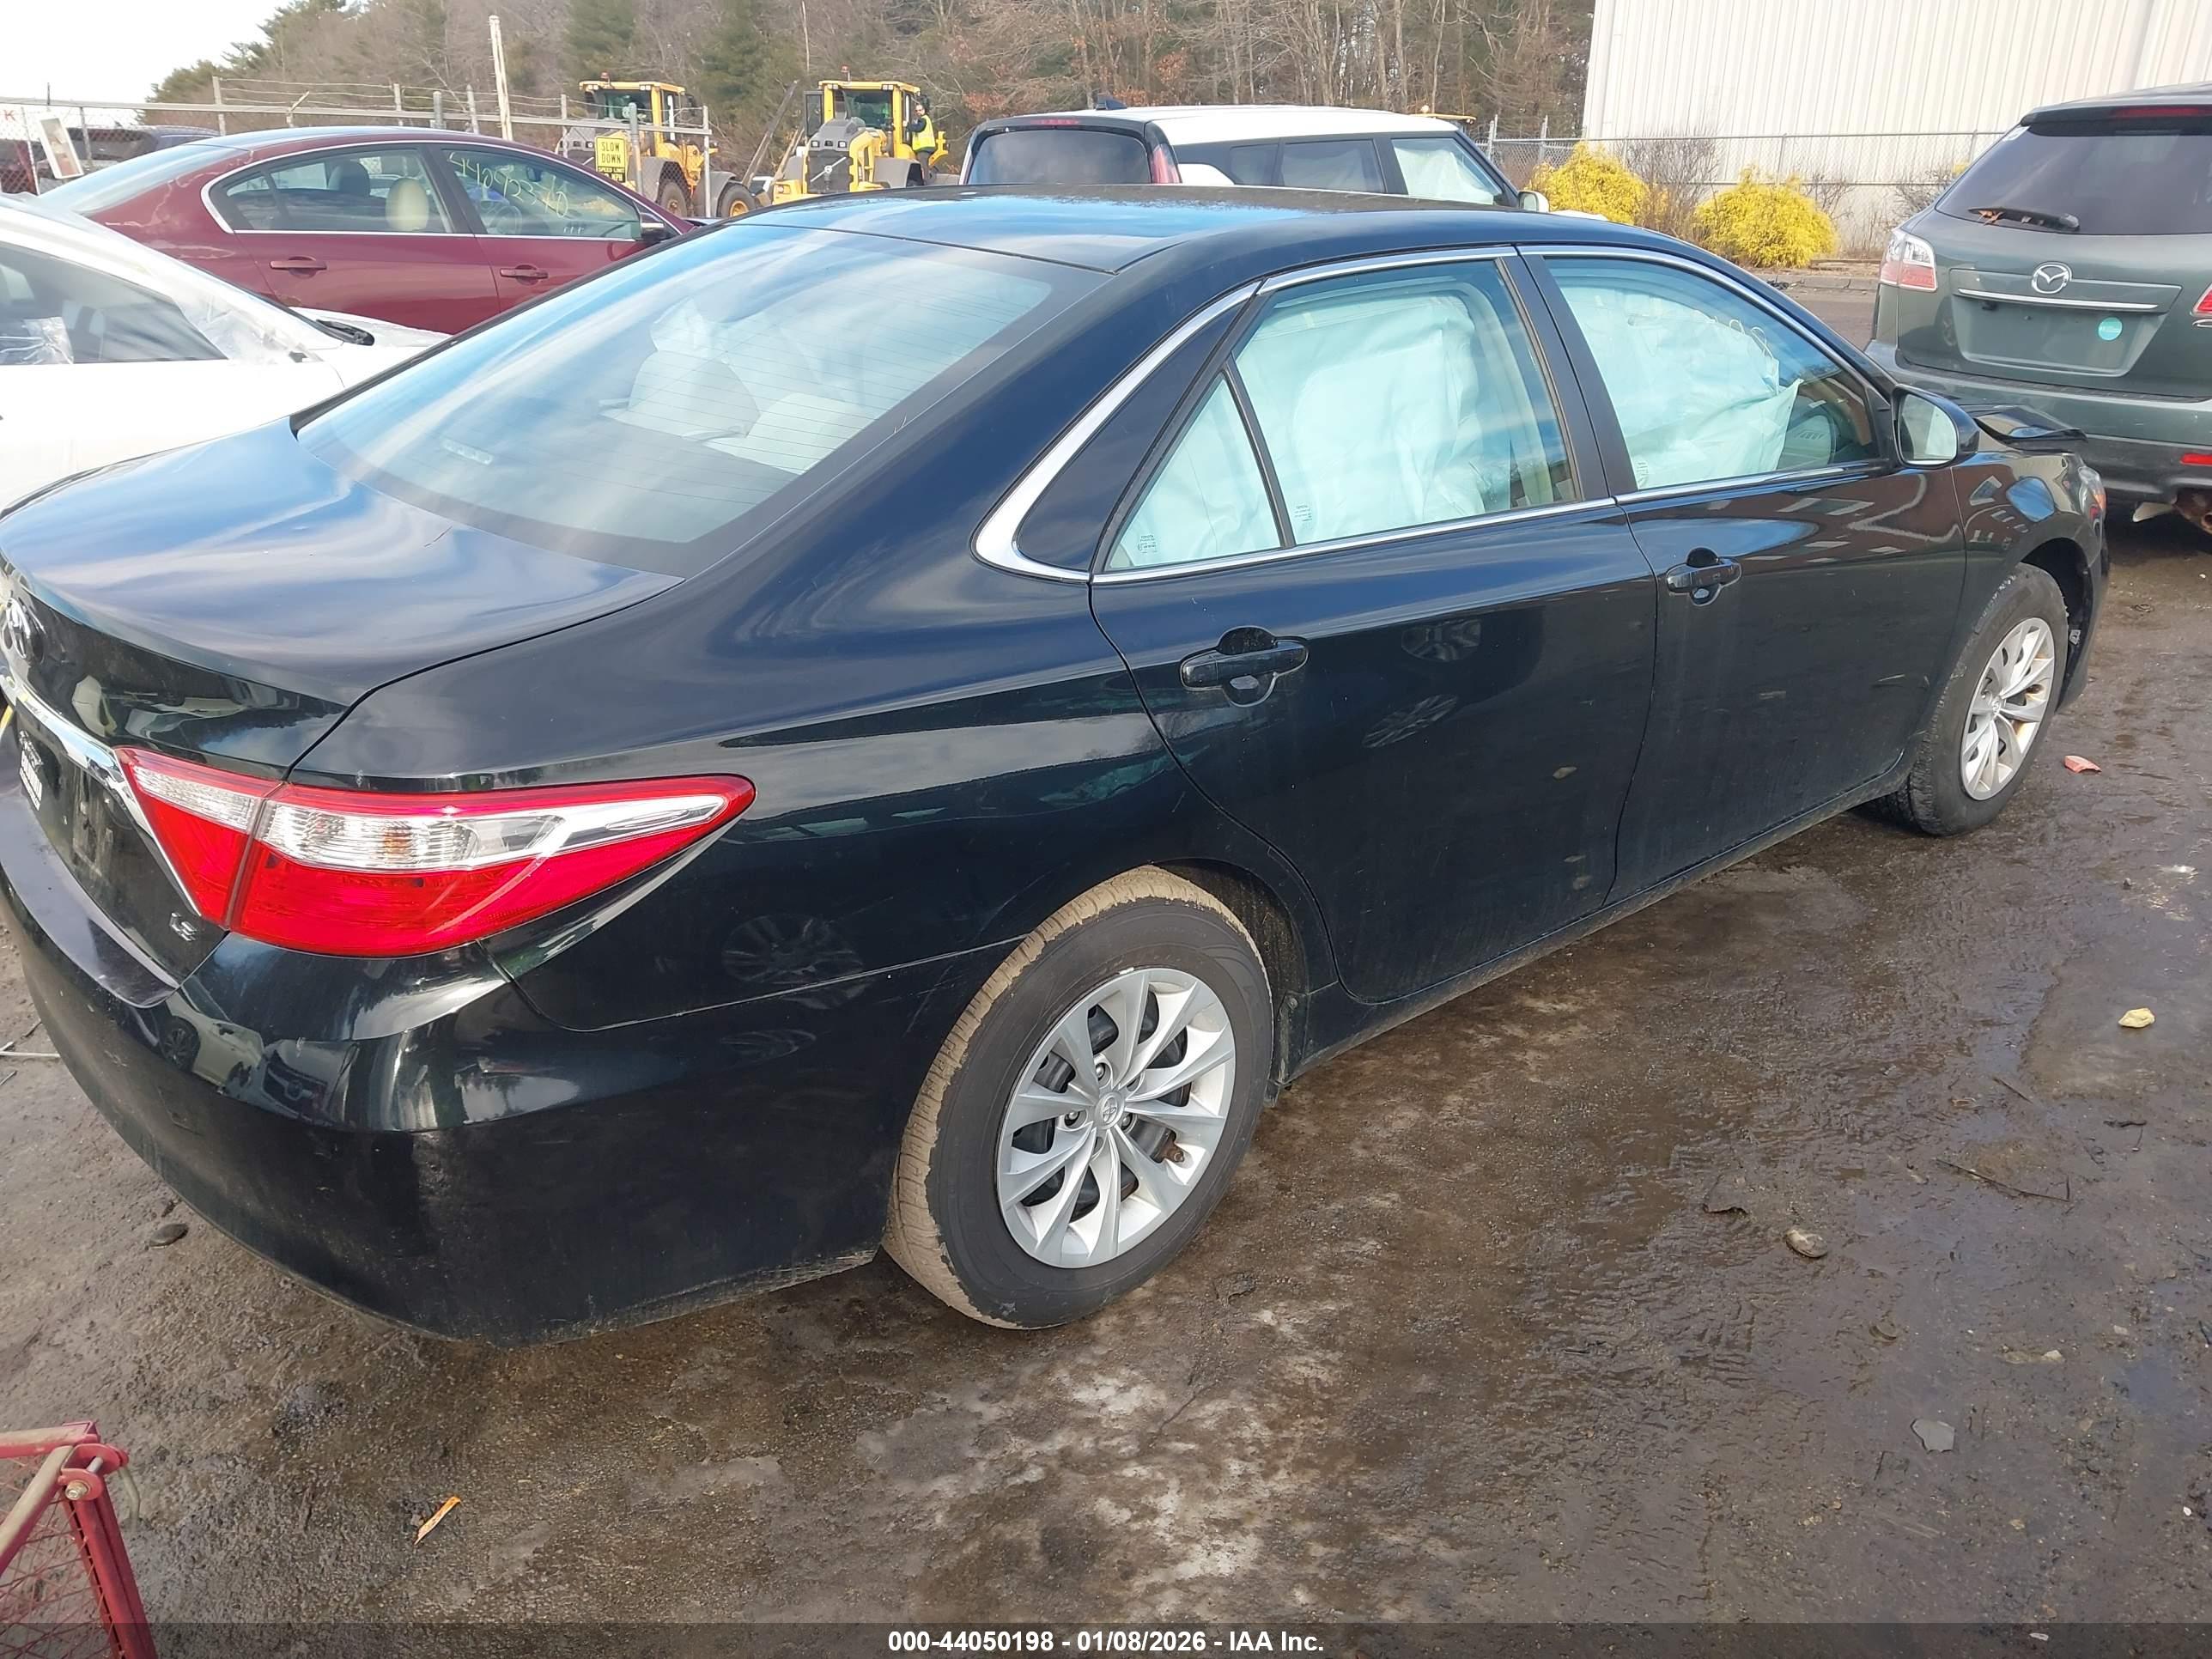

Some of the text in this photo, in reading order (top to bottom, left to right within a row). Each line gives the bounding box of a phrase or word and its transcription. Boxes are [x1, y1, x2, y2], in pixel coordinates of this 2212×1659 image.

[601, 142, 620, 152] SLOW
[601, 153, 621, 163] DOWN
[169, 912, 198, 941] LE
